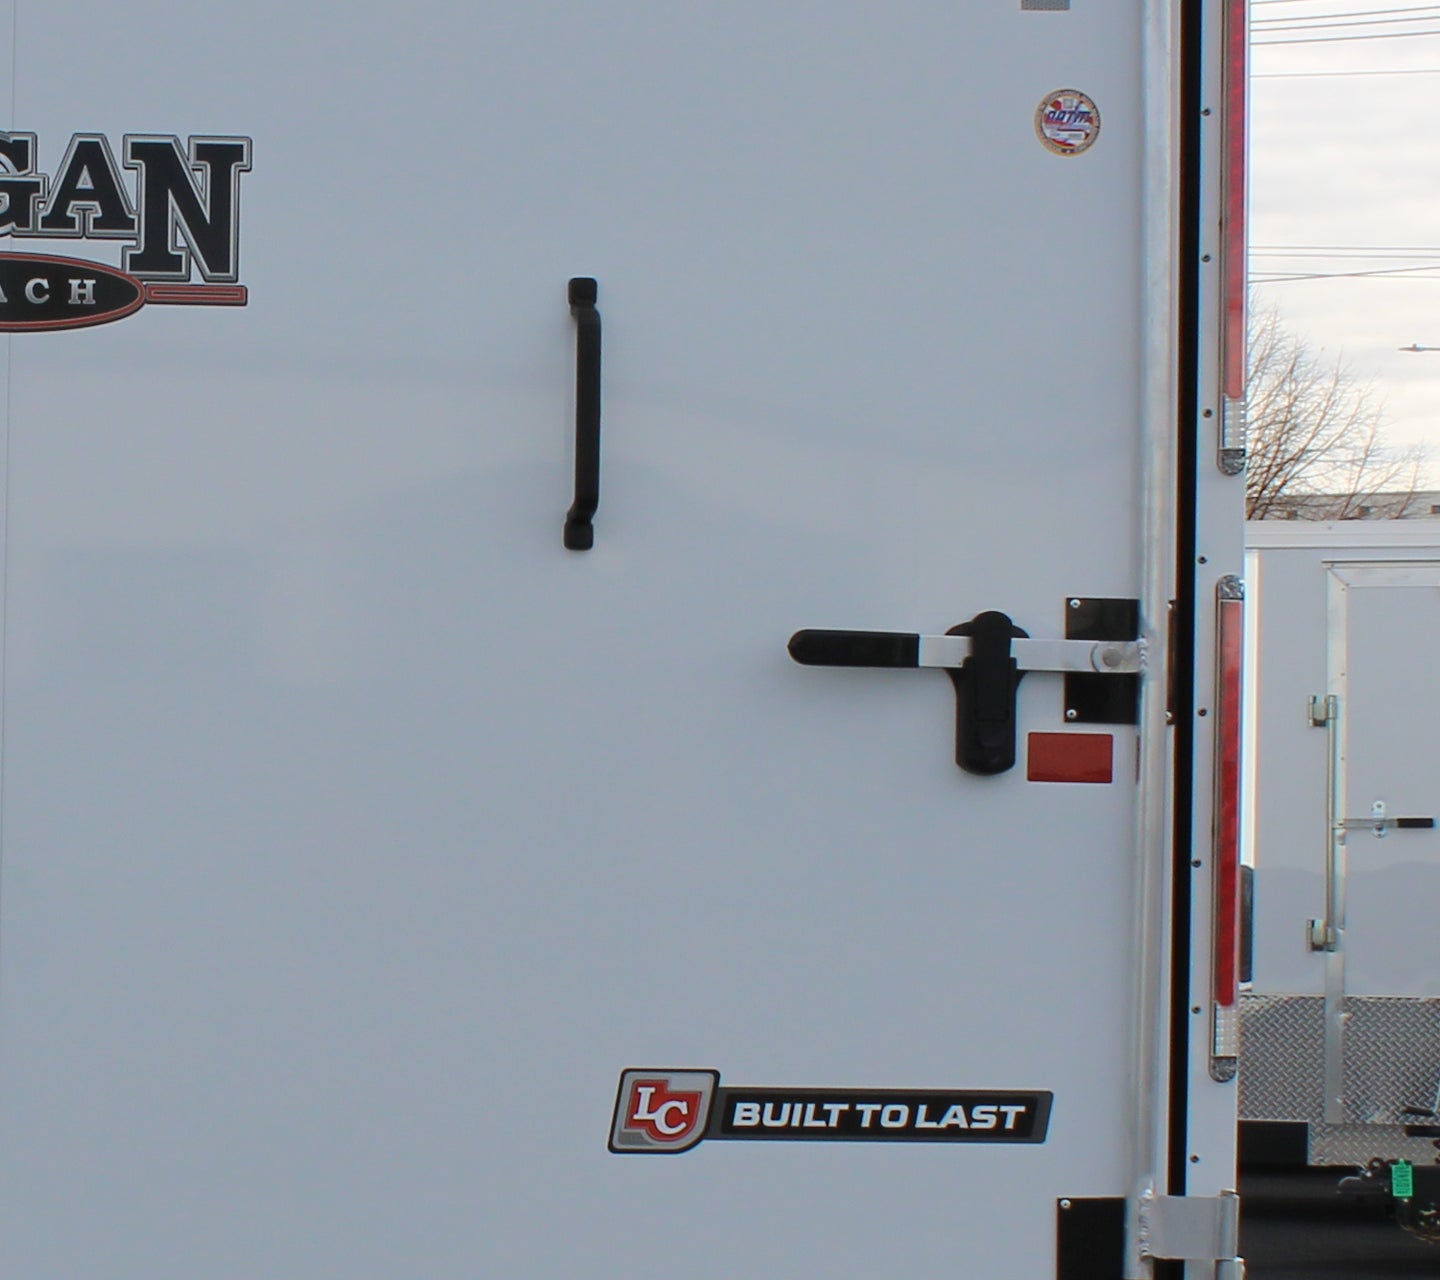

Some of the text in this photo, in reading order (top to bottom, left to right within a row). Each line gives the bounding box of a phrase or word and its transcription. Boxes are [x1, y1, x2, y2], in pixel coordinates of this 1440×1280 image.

[632, 1086, 689, 1135] LC
[732, 1101, 1026, 1131] BUILT TO LAST
